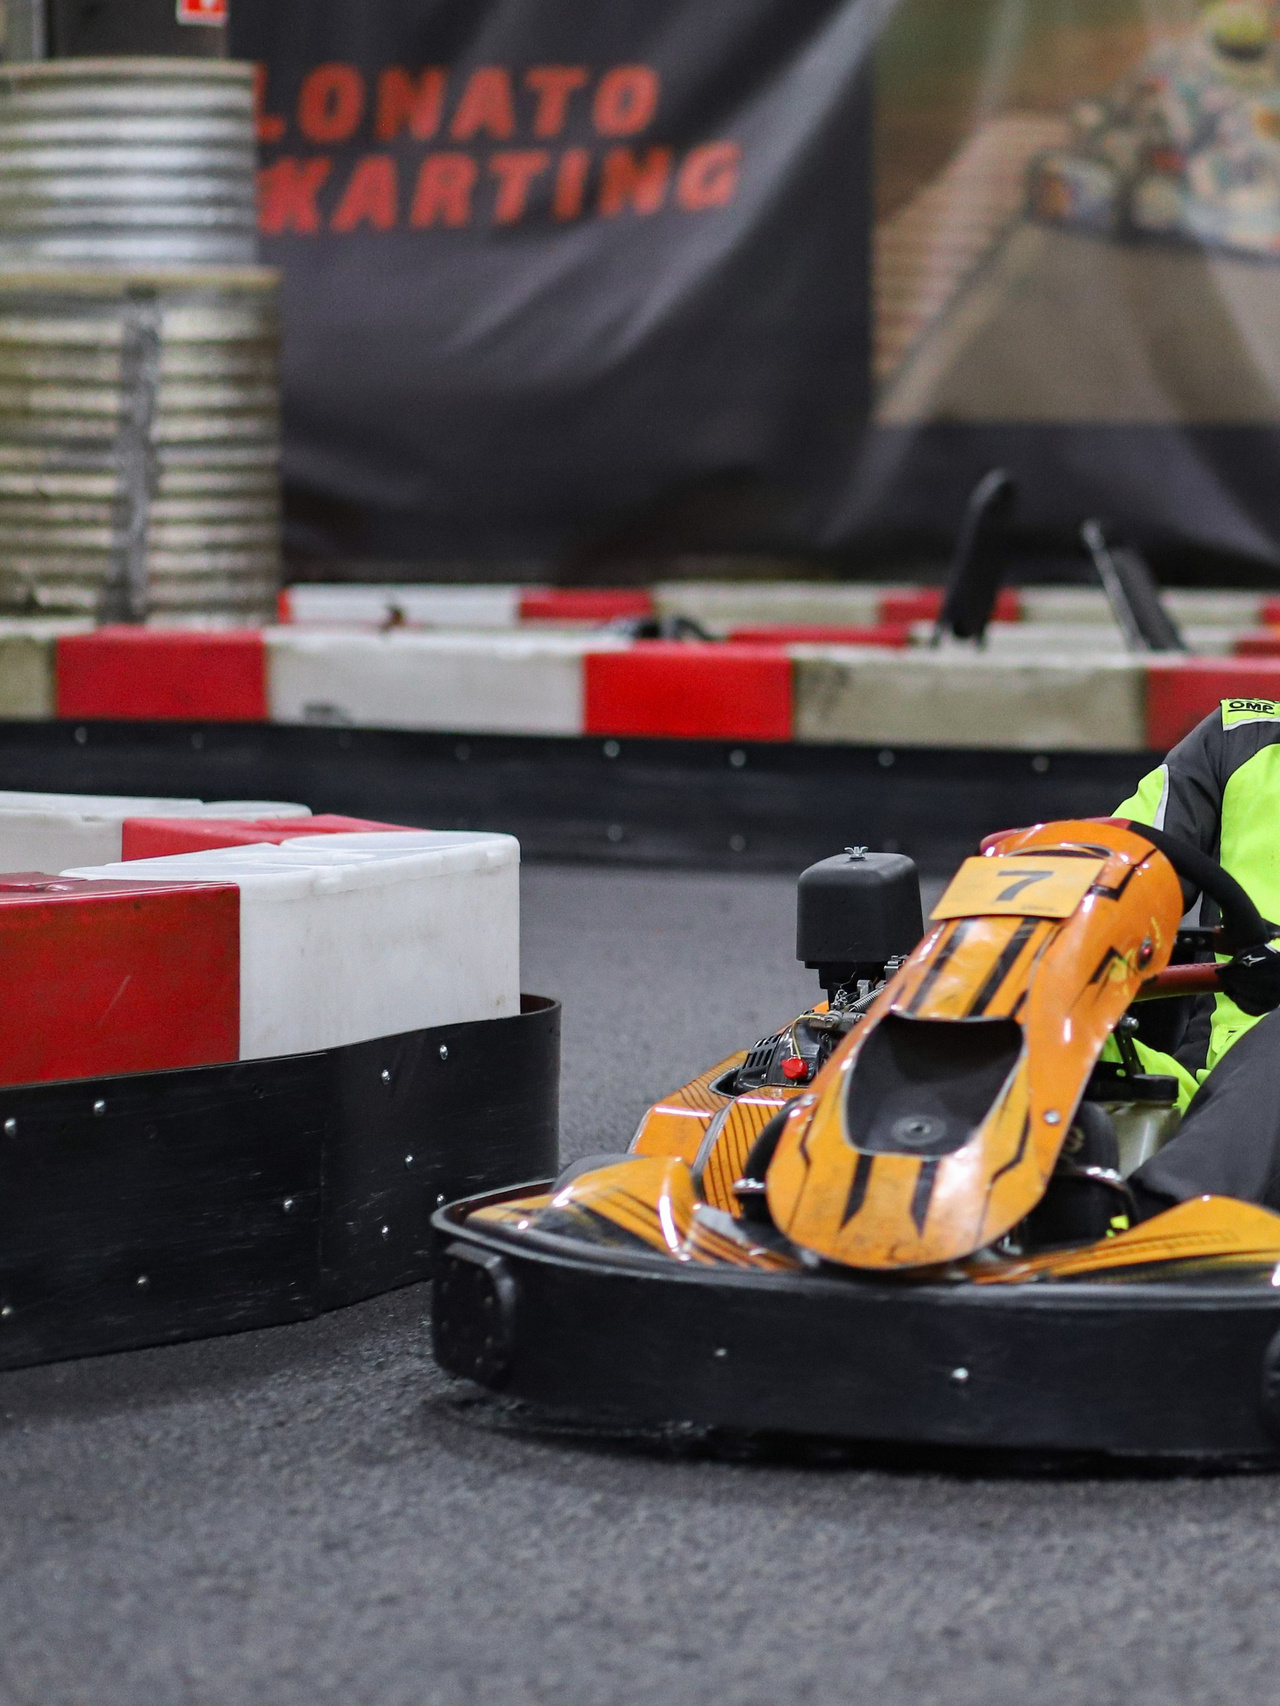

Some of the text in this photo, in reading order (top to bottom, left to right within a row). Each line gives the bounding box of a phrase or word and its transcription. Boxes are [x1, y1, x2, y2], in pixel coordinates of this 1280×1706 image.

[255, 63, 659, 142] LONATO
[257, 139, 740, 235] KARTING
[1228, 700, 1275, 713] OMP
[995, 869, 1055, 903] 7
